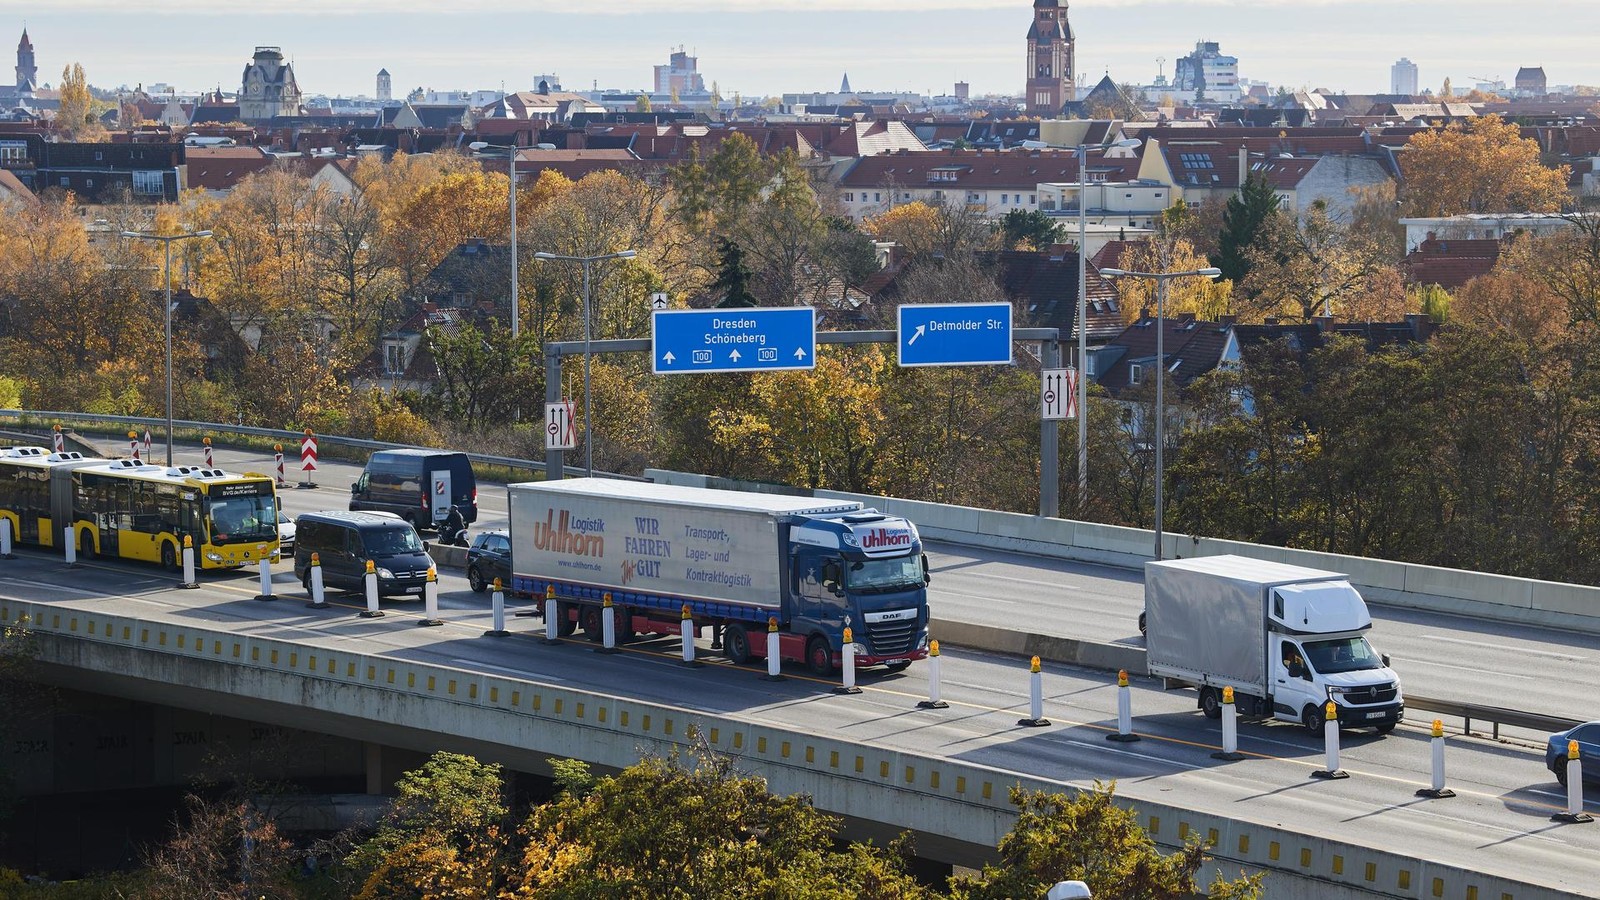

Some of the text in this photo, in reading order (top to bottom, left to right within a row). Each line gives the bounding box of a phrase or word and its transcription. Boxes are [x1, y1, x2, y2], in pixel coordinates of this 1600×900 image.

[713, 318, 756, 329] Dresden
[929, 318, 1004, 331] Detmolder Str.
[704, 333, 766, 345] Schöneberg
[695, 350, 775, 361] 100 100
[571, 516, 605, 534] Logistik
[634, 516, 660, 536] WIR
[685, 525, 730, 544] Transport-,
[625, 536, 671, 558] FAHREN
[685, 546, 730, 563] Lager- und
[558, 560, 602, 572] www.uhlhorn.de
[637, 559, 661, 579] GUT
[686, 567, 752, 588] Kontraktlogistik
